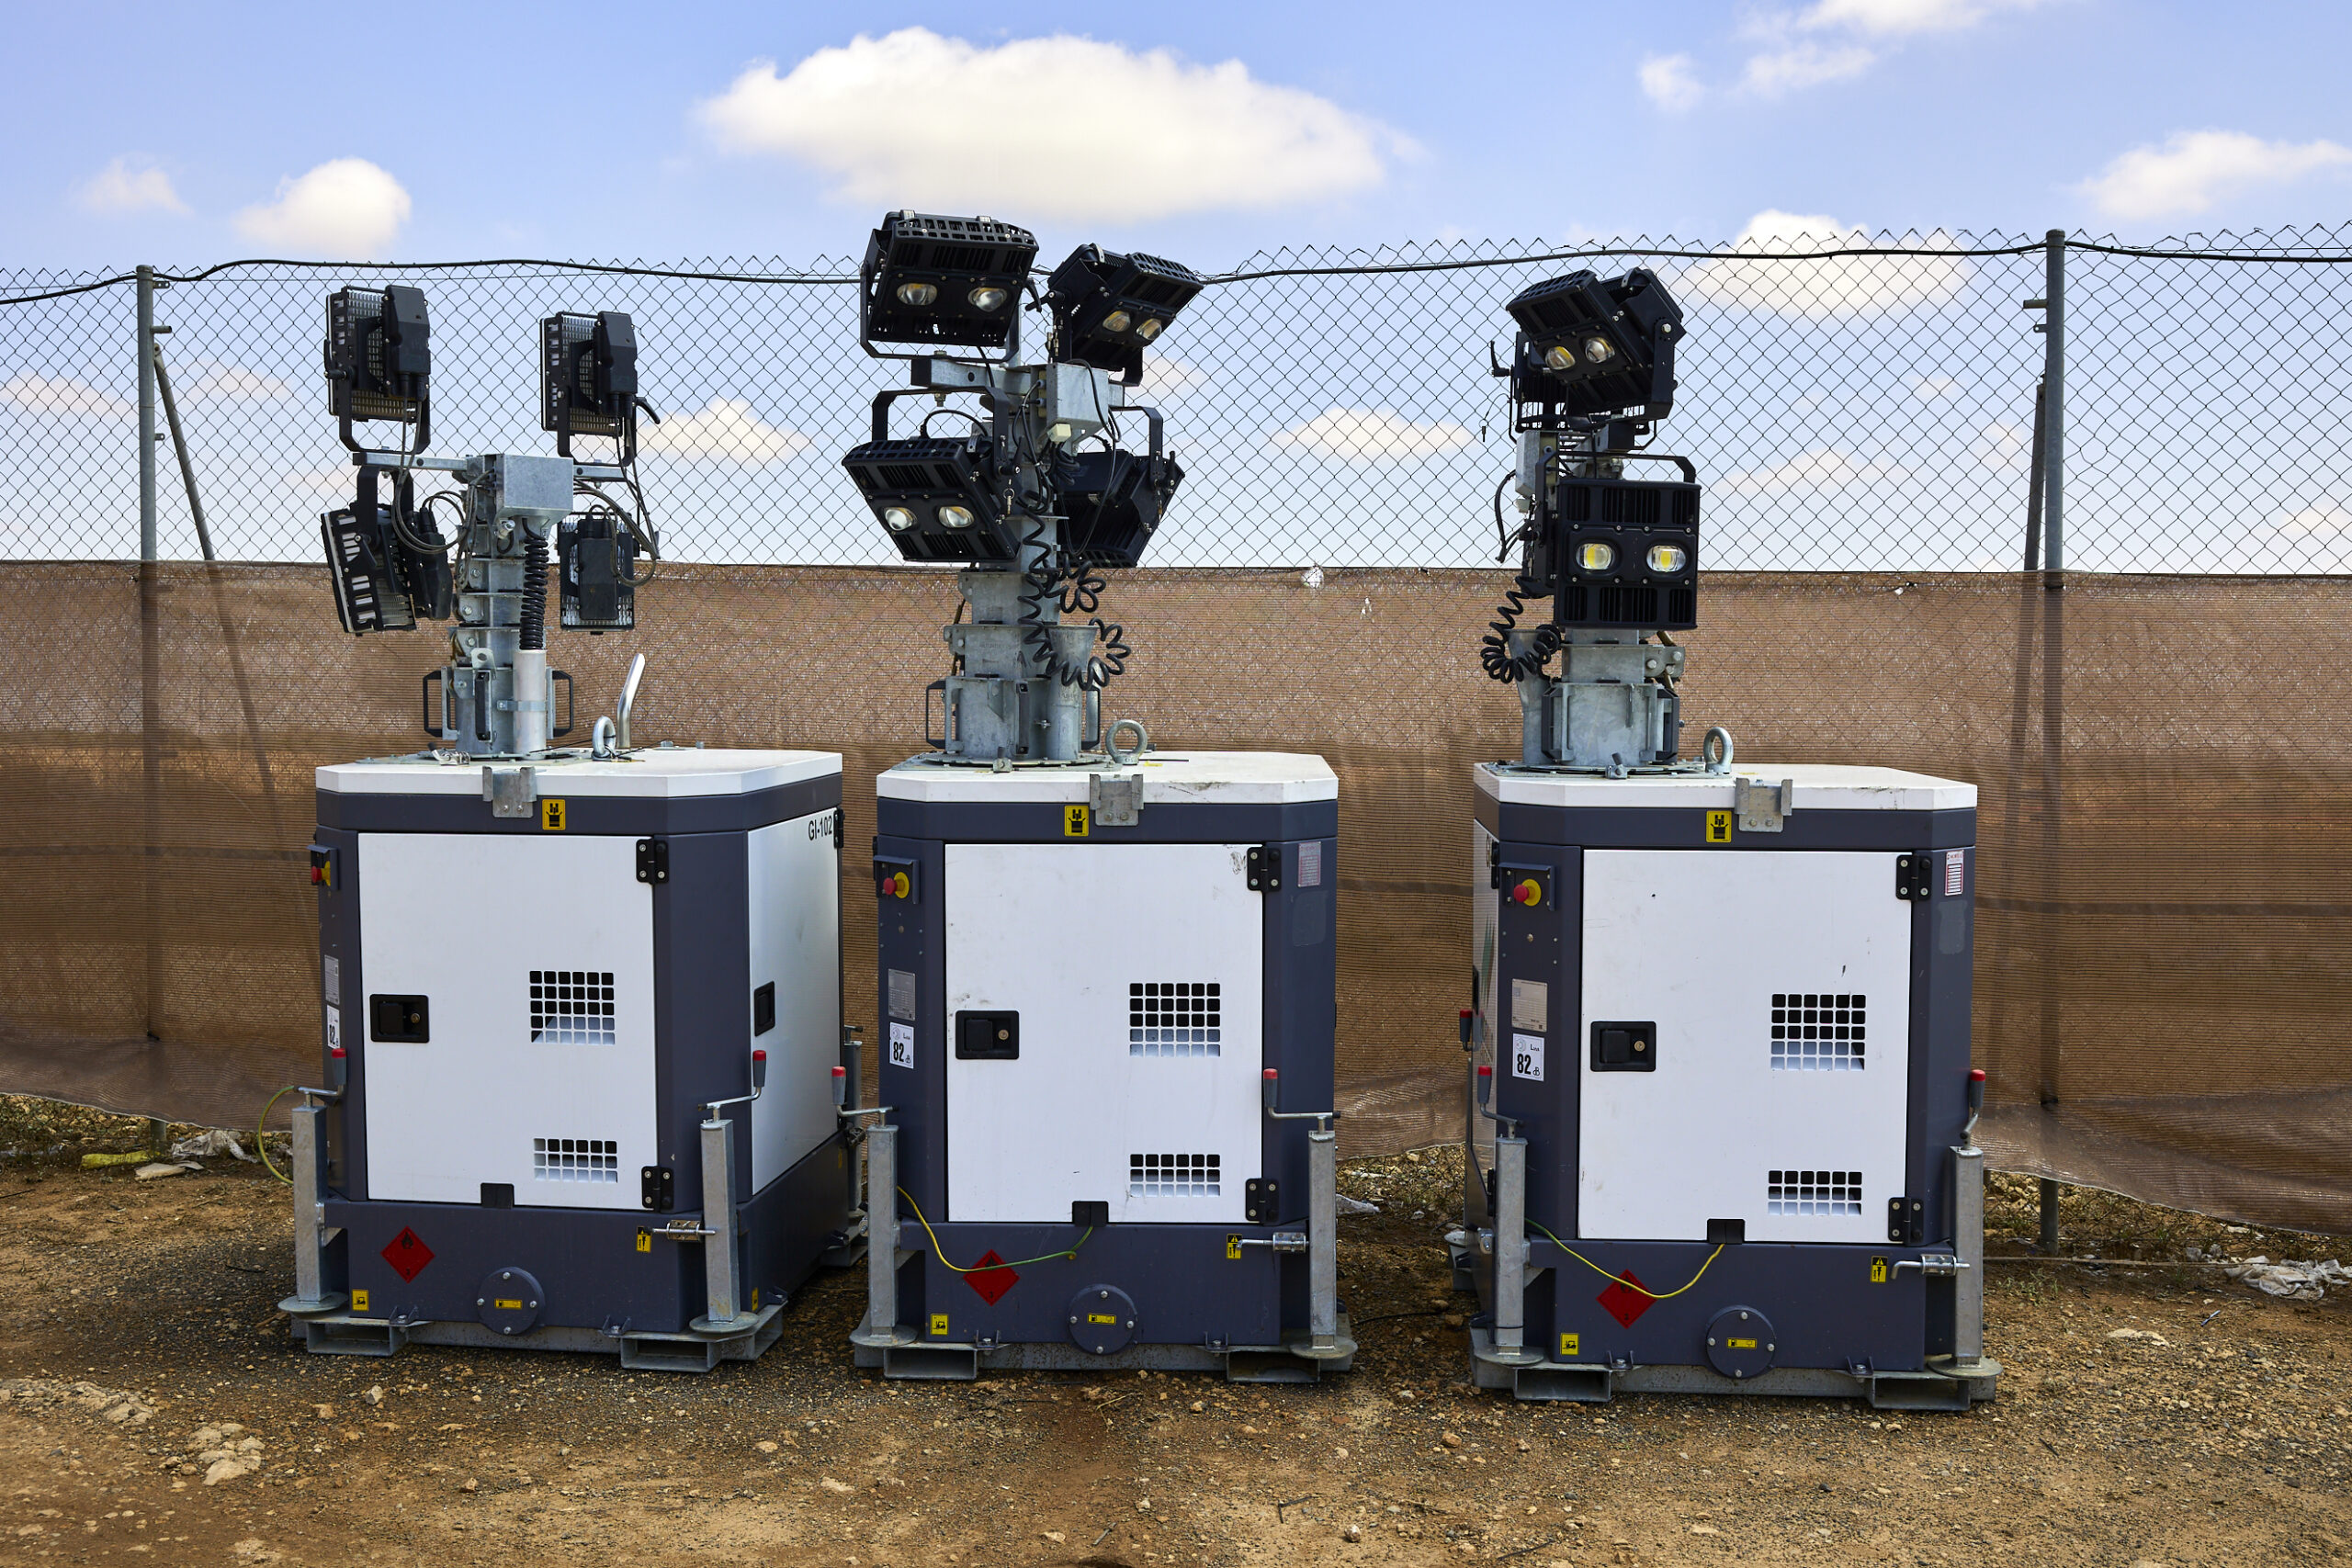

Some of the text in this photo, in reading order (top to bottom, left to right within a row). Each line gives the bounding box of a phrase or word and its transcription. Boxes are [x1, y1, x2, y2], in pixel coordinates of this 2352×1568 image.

[808, 815, 833, 841] GI-102
[893, 1041, 905, 1063] 82
[1517, 1053, 1532, 1076] 82
